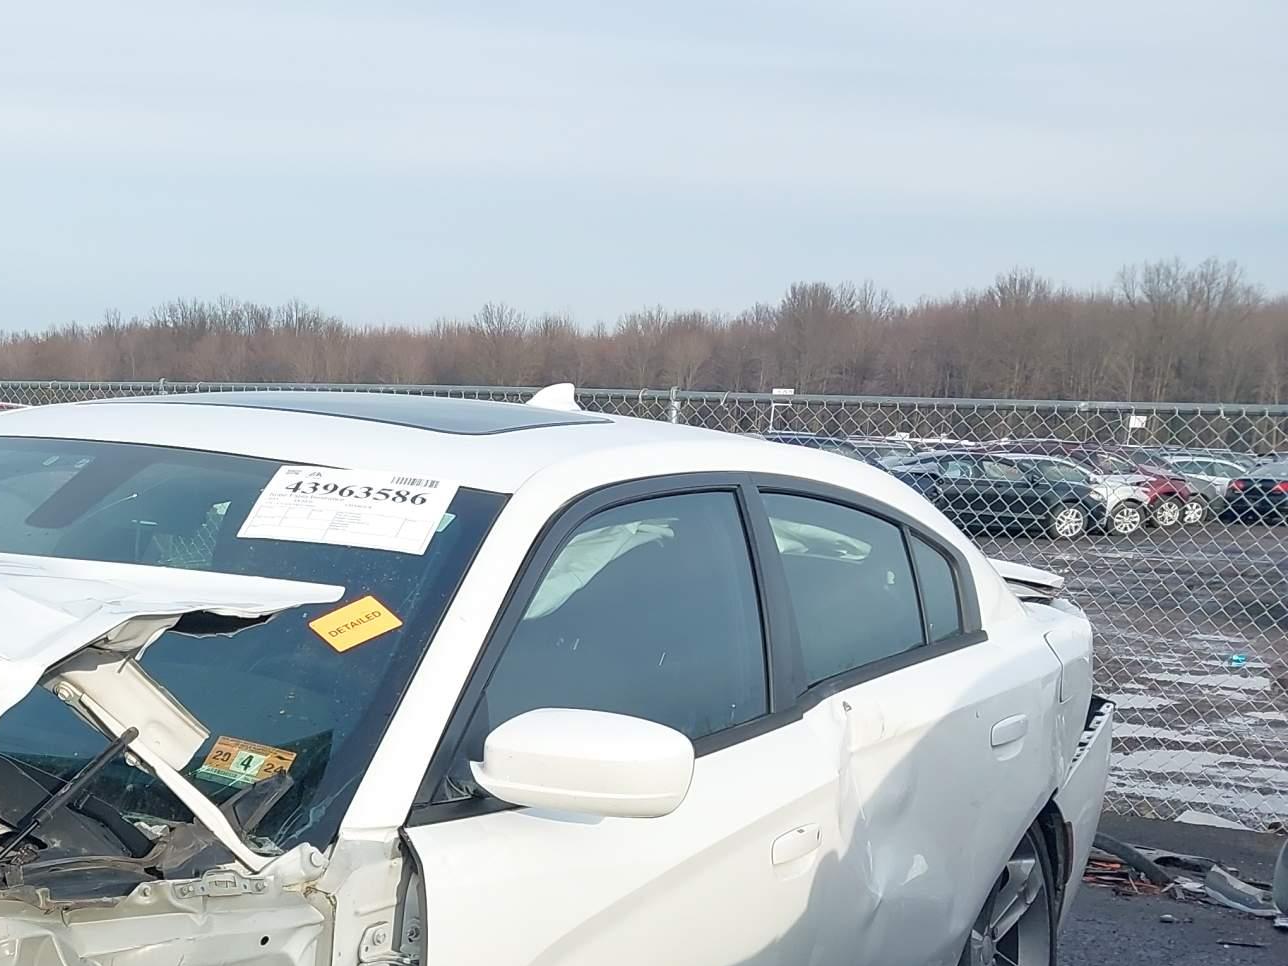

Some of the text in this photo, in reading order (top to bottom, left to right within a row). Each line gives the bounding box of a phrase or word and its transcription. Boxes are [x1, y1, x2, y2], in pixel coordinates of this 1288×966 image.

[285, 480, 432, 506] 43963586
[327, 610, 383, 639] DETAILED
[212, 750, 232, 762] 20
[240, 755, 254, 771] 4
